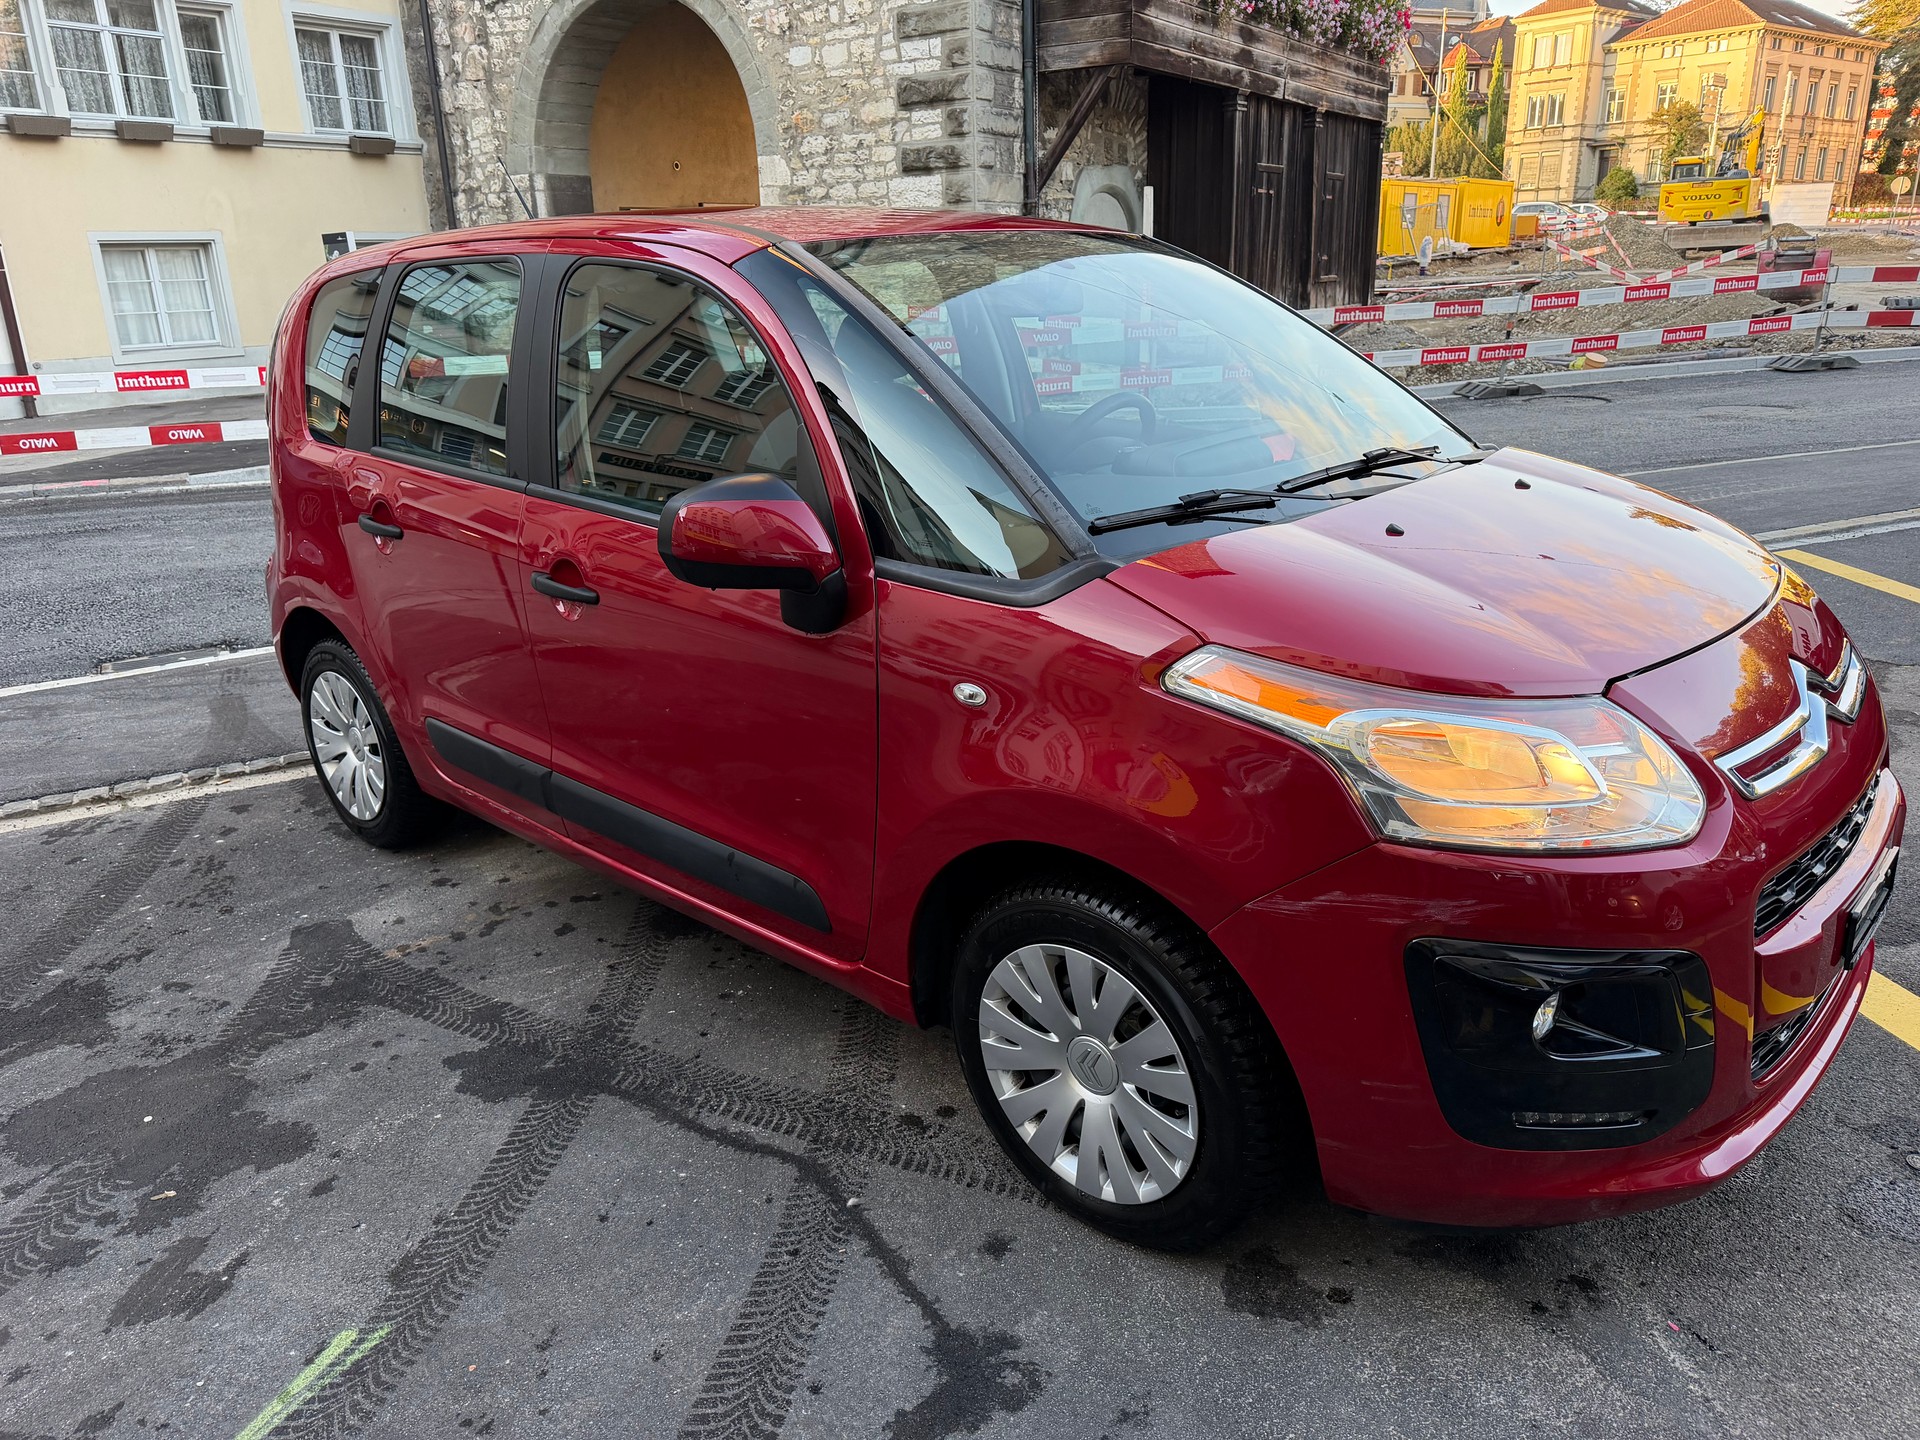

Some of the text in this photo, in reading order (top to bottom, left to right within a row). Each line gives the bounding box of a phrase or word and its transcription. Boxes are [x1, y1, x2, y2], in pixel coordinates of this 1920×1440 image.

[1682, 193, 1722, 202] VOLVO
[1803, 272, 1825, 283] Imth
[1715, 279, 1755, 291] Imthurn
[1626, 286, 1668, 299] Imthurn
[1533, 295, 1576, 308] Imthurn
[1335, 309, 1383, 322] Imthurn
[1435, 303, 1481, 316] Imthurn
[1750, 320, 1790, 332] Imthurn
[1033, 333, 1059, 343] WALO
[1663, 329, 1703, 342] Imthurn
[1573, 338, 1615, 350] Imthurn
[1423, 350, 1467, 362] Imthurn
[1480, 347, 1524, 360] Imthurn
[1050, 362, 1072, 372] WALO
[1224, 367, 1254, 379] Imth
[117, 375, 185, 388] Imthurn
[1123, 374, 1169, 386] Imthurn
[1036, 381, 1070, 393] thurn
[168, 429, 205, 440] WALO
[19, 437, 59, 449] WALO
